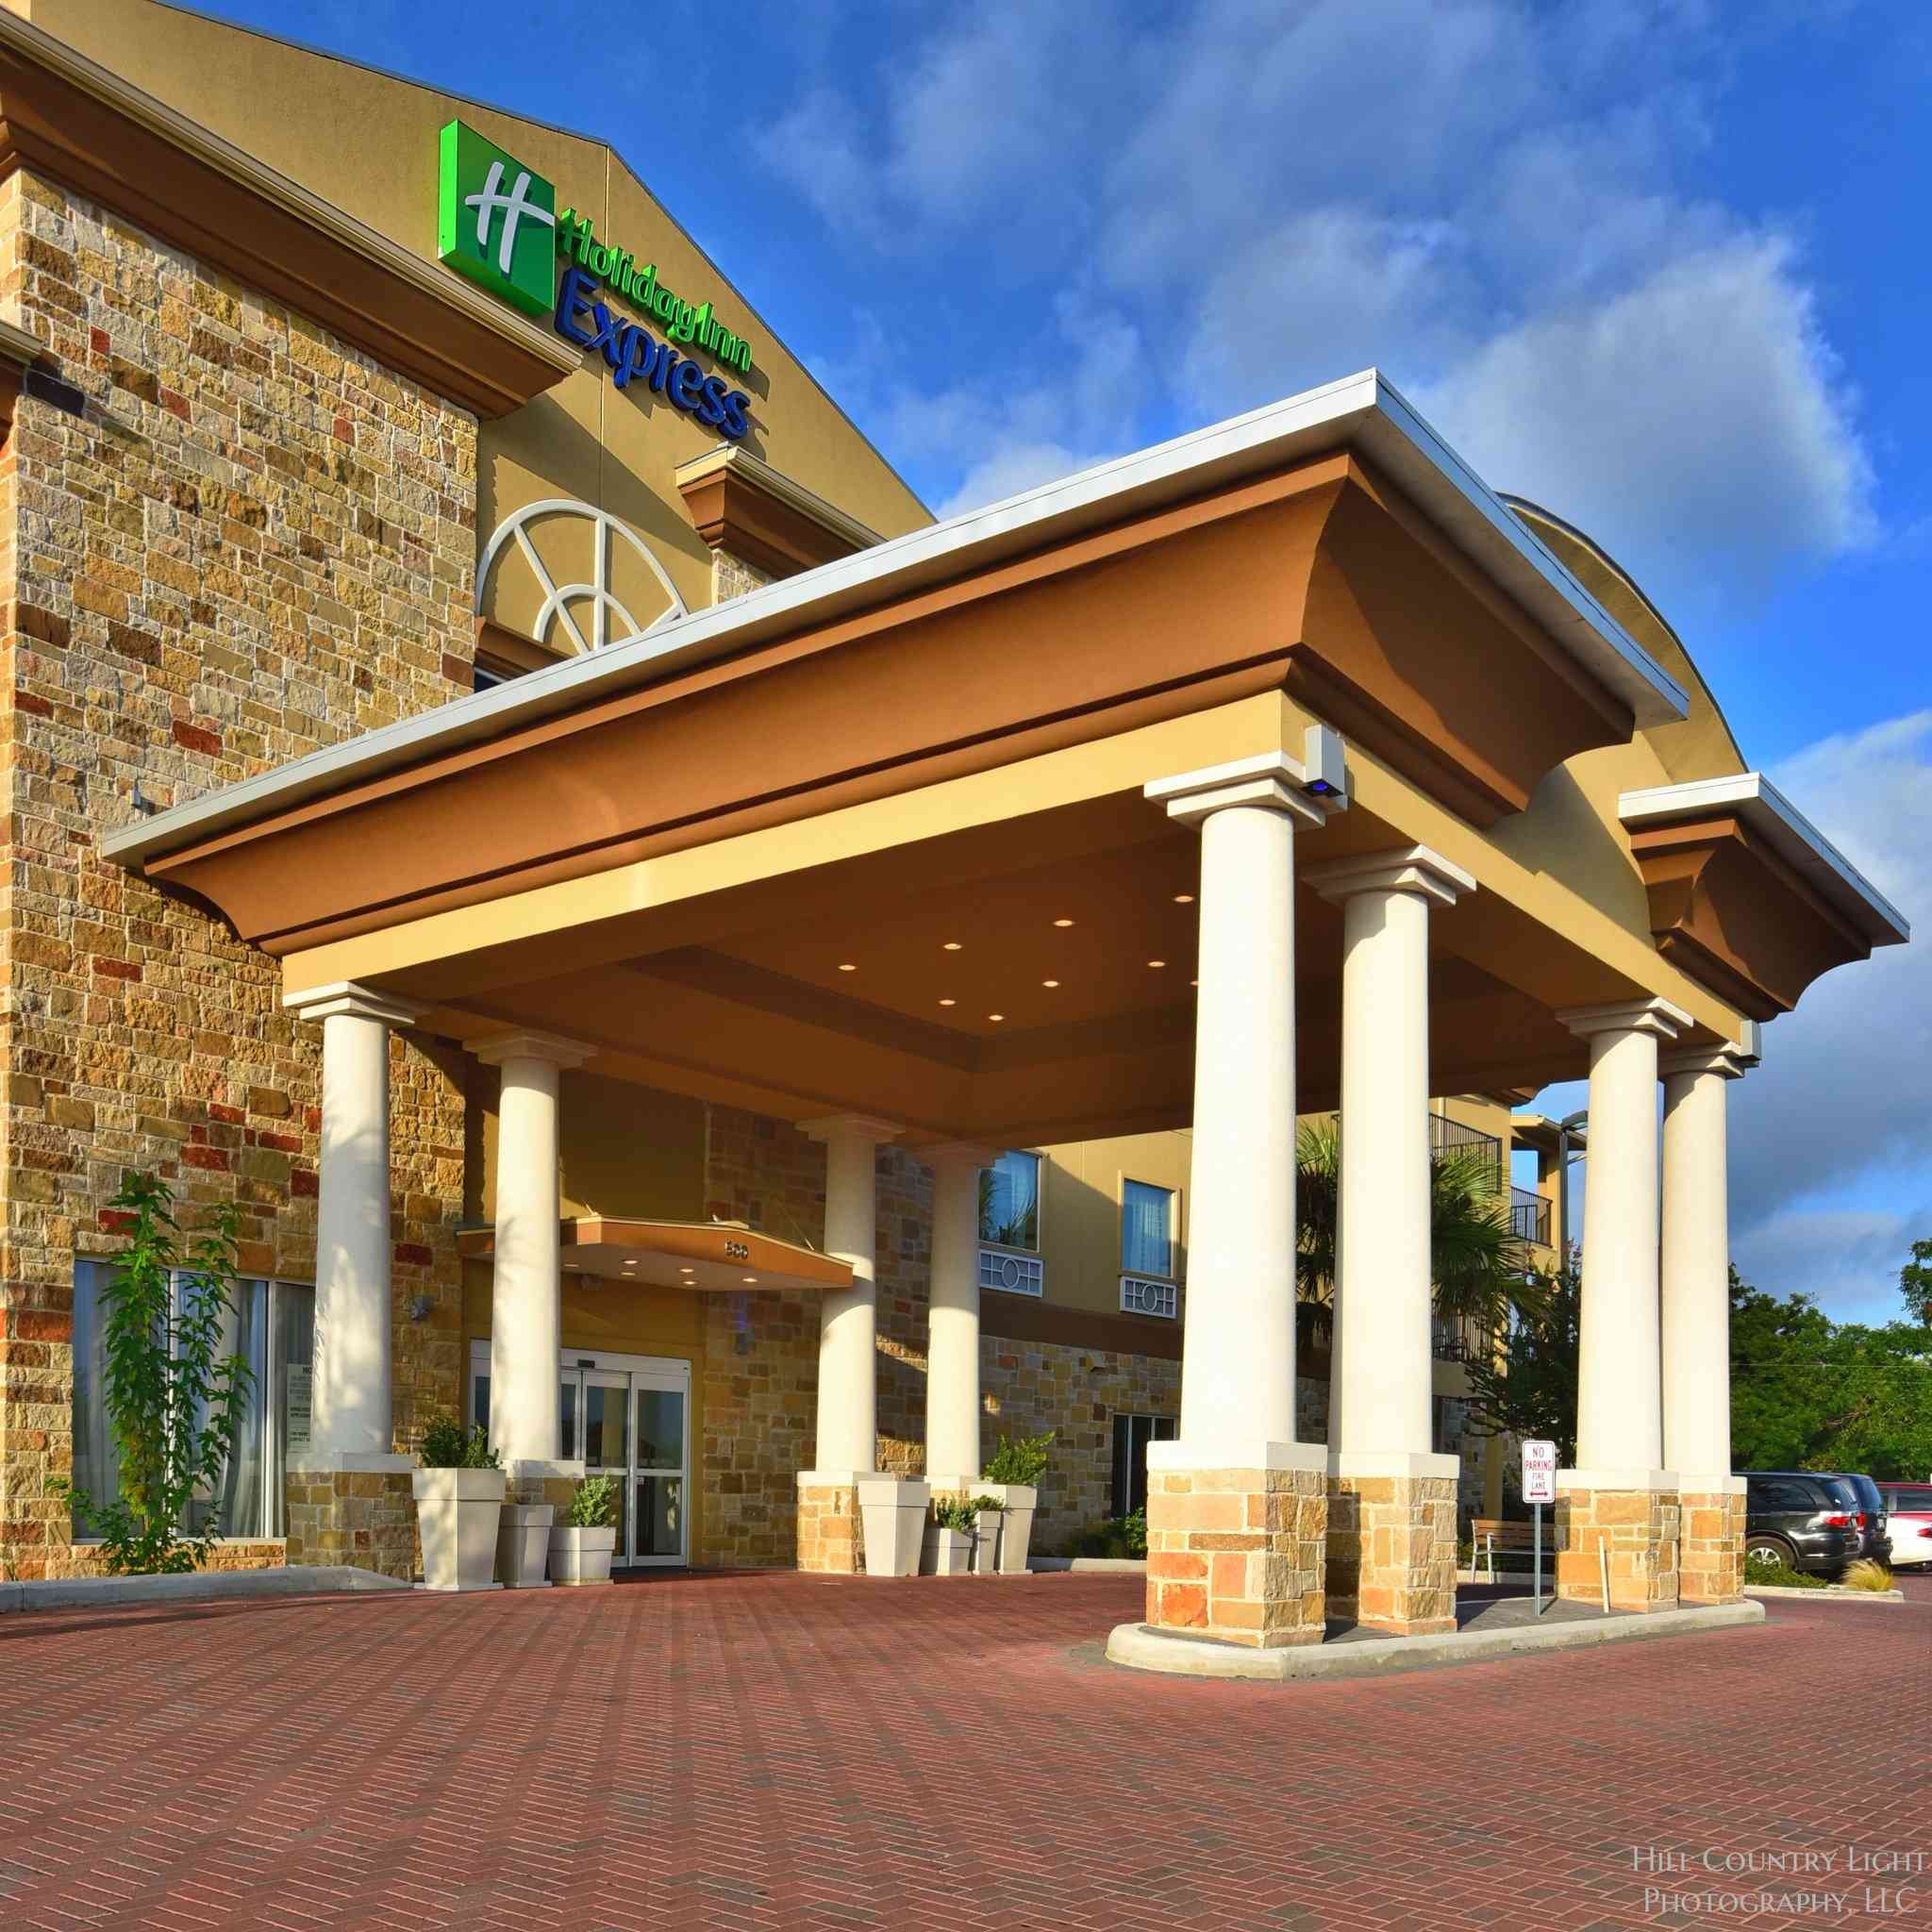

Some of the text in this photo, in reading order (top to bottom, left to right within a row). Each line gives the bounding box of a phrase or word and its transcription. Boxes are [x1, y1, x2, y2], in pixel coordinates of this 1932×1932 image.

[556, 207, 753, 374] Holiday Inn
[554, 266, 753, 441] Express
[1533, 1447, 1544, 1458] NO
[1524, 1459, 1553, 1470] PARKING
[1531, 1481, 1546, 1490] LANE
